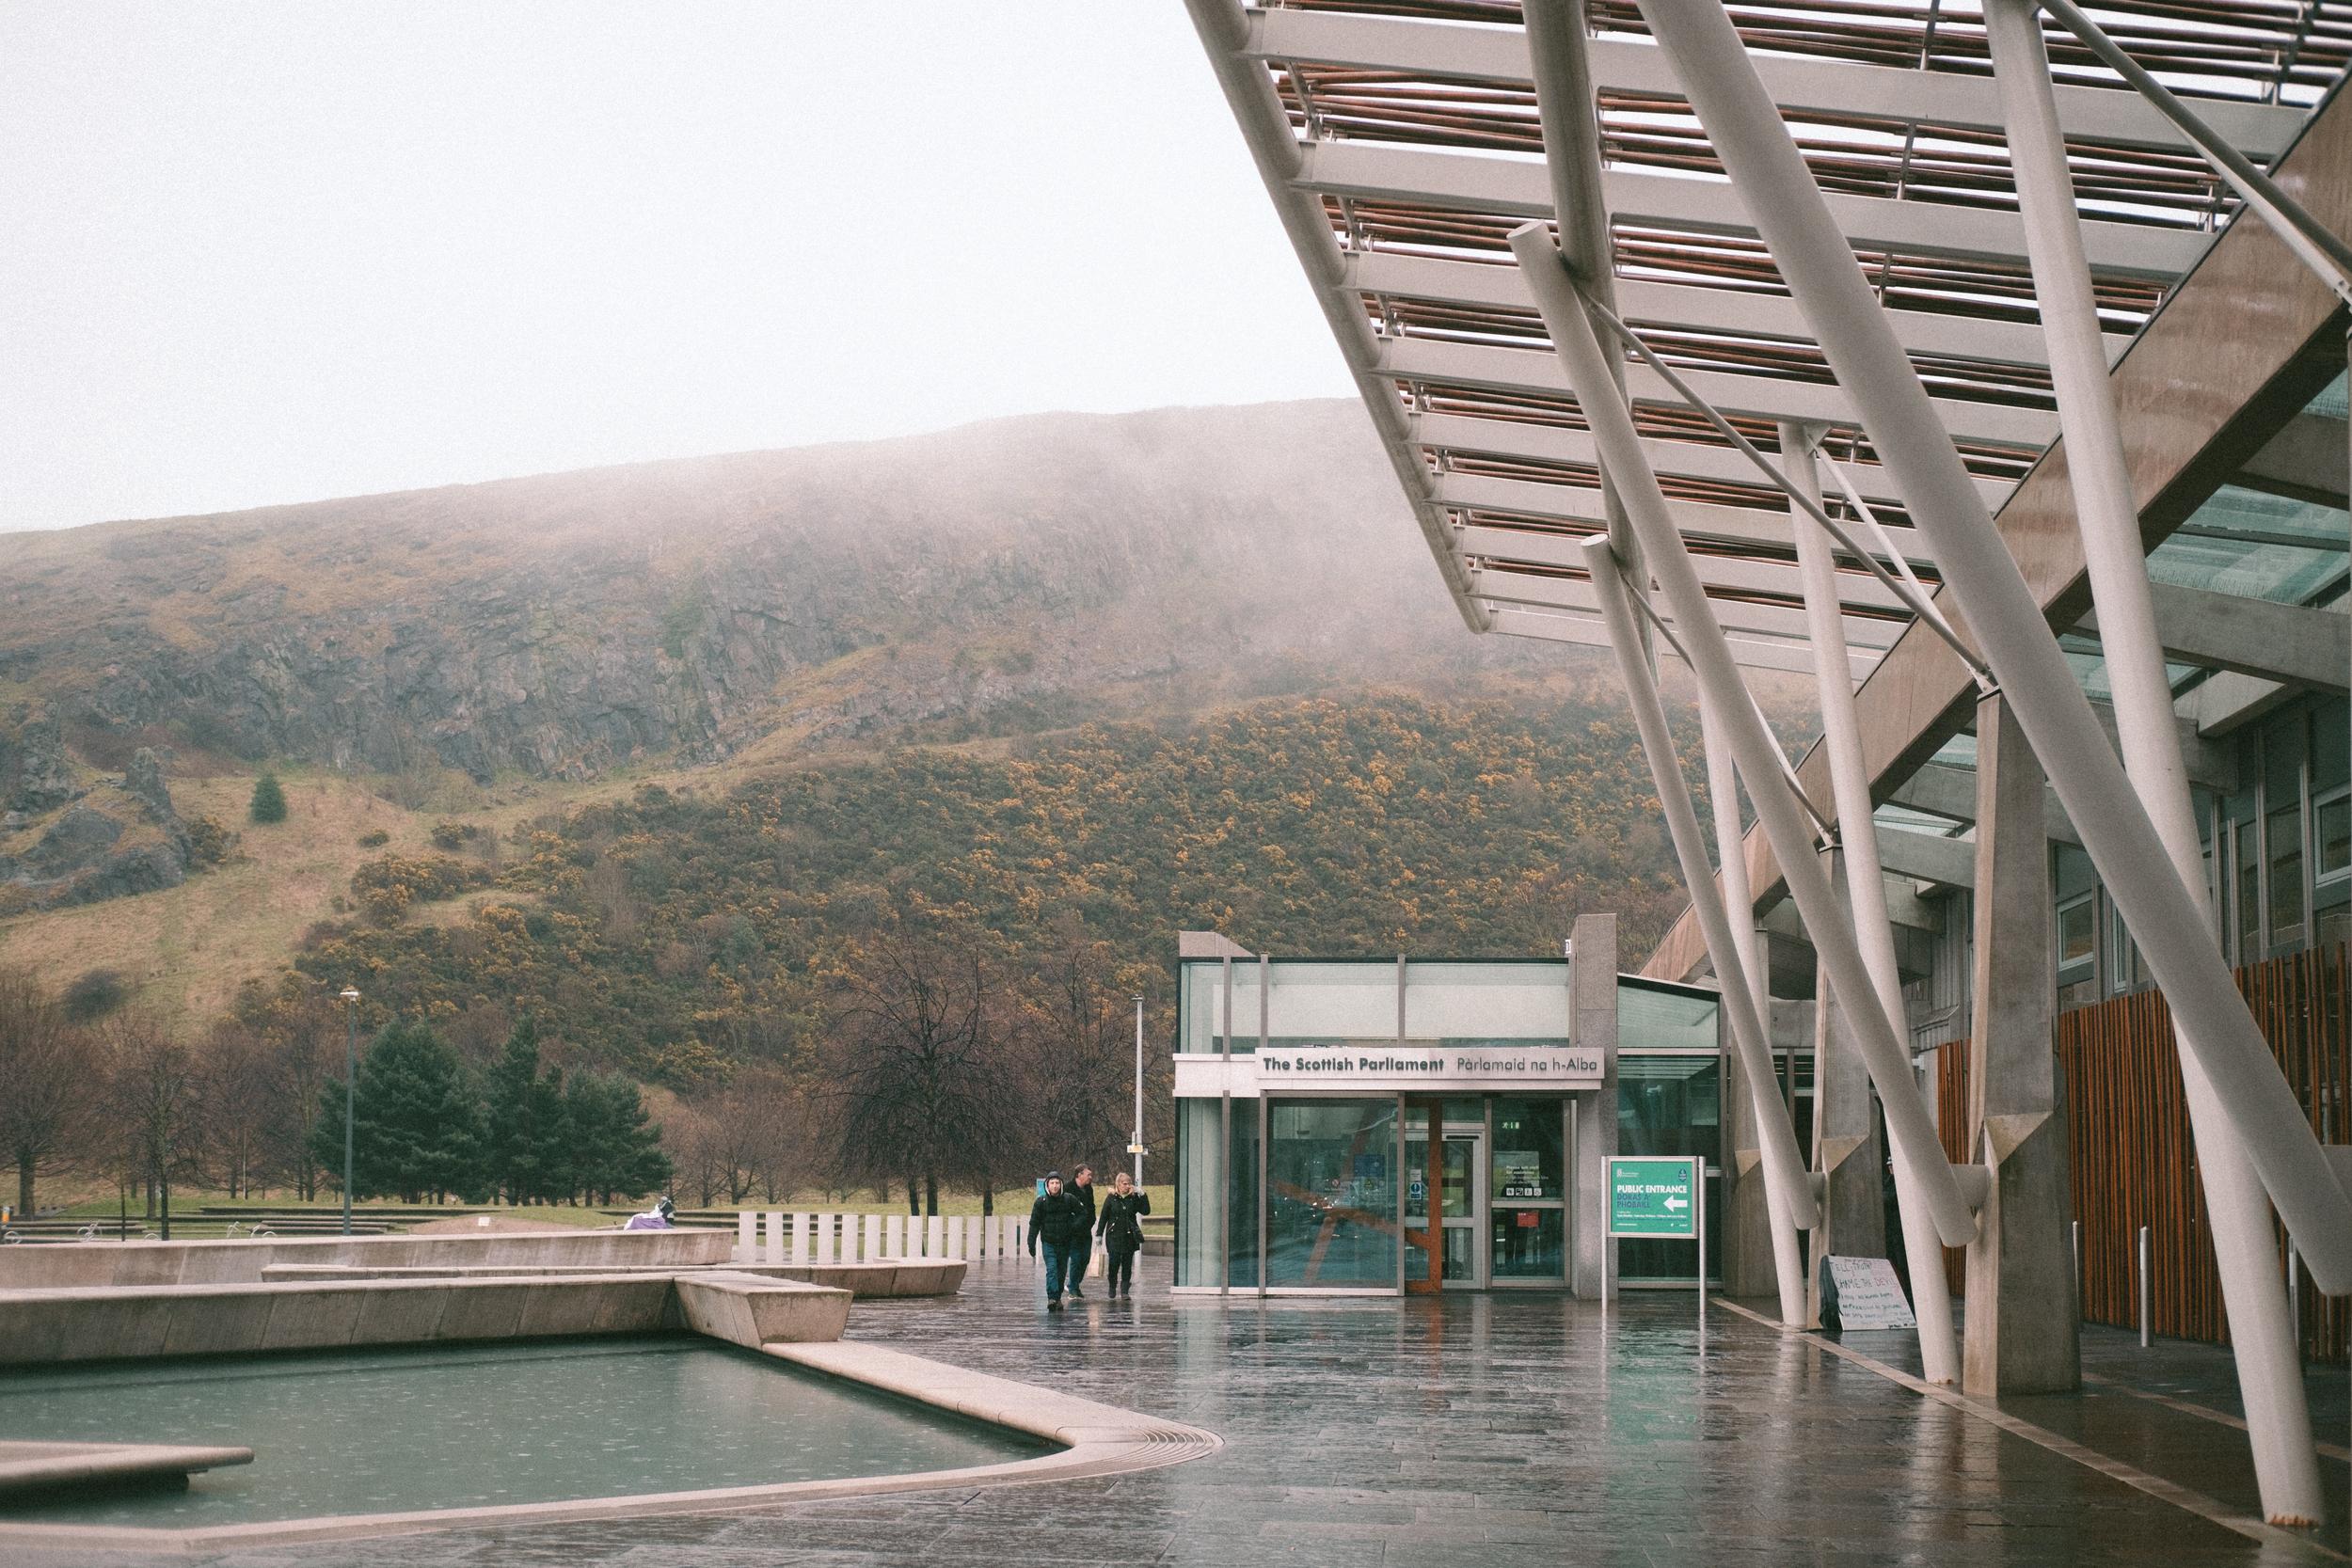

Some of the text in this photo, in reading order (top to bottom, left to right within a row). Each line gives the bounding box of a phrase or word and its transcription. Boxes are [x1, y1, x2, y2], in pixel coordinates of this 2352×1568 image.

[1263, 1057, 1597, 1071] The Scottish Parliament Pàrlamaid na h-Alba
[1617, 1184, 1687, 1194] PUBLIC ENTRANCE
